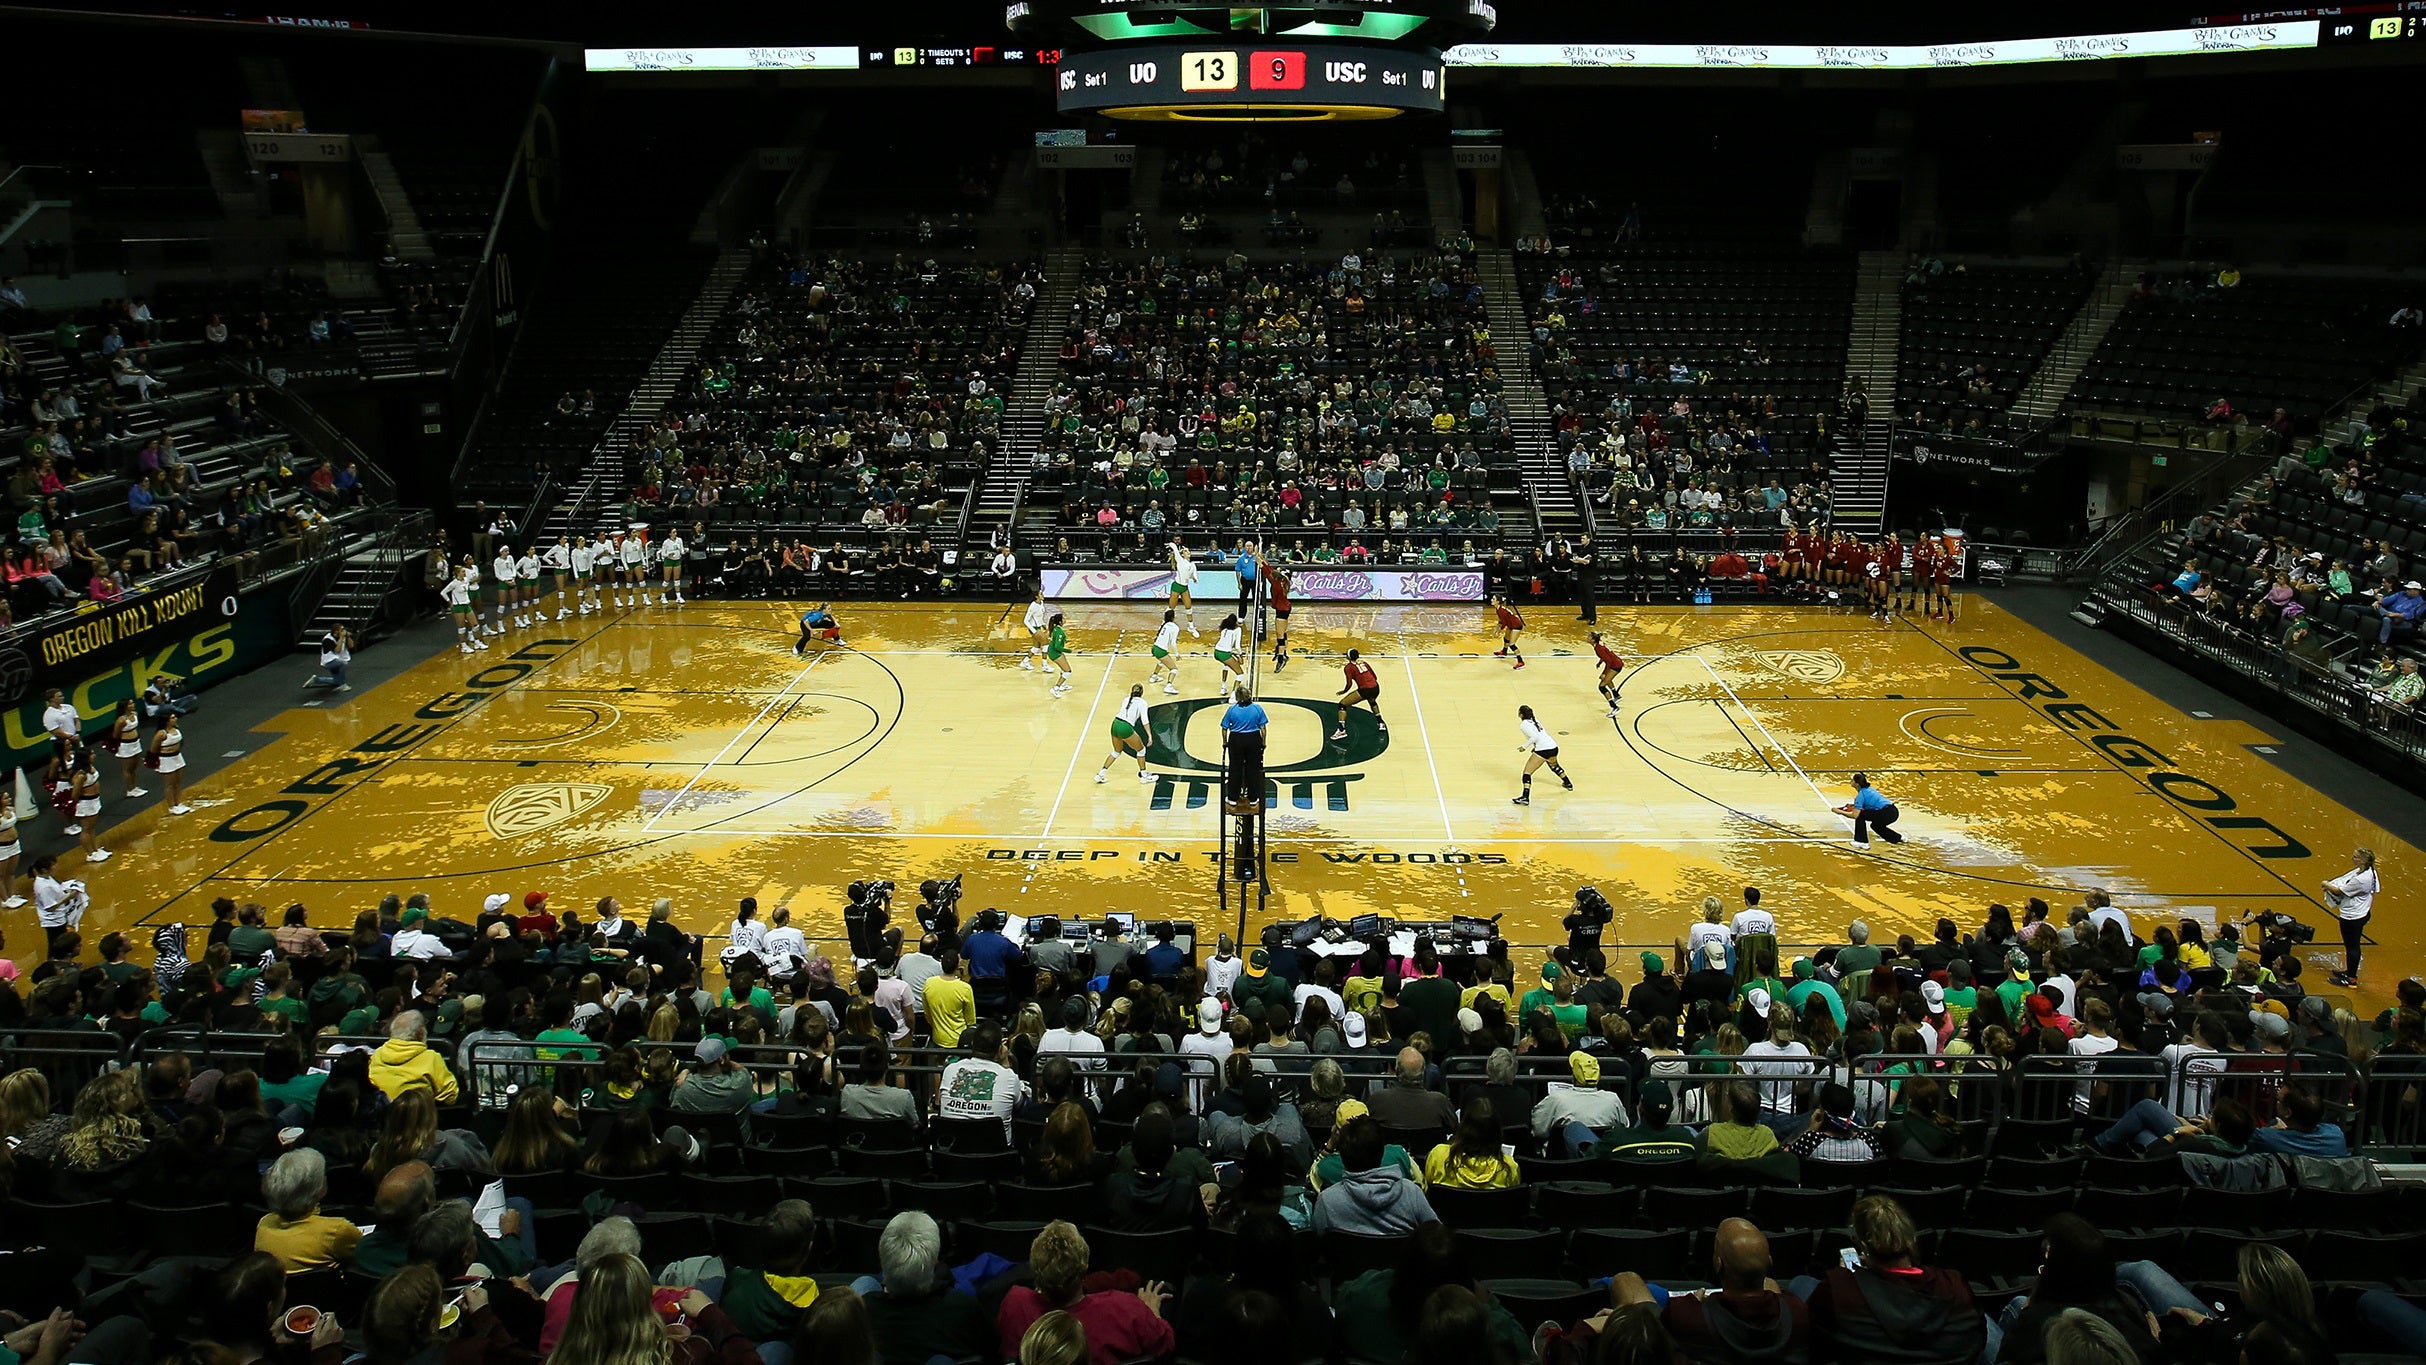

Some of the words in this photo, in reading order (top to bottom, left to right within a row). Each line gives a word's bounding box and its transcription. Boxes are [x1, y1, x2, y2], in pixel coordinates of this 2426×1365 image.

[2377, 22, 2396, 35] 13
[2409, 18, 2416, 26] 2
[899, 52, 913, 62] 13
[1004, 51, 1023, 60] USC
[1130, 62, 1157, 84] UO
[1195, 58, 1224, 81] 13
[1271, 58, 1286, 81] 9
[1326, 62, 1367, 82] USC
[1060, 70, 1076, 91] USC
[1085, 73, 1100, 87] Set
[1101, 71, 1106, 86] 1
[1382, 71, 1401, 86] Set
[1402, 72, 1407, 86] 1
[1422, 70, 1435, 89] UO
[252, 143, 279, 154] 120
[320, 144, 343, 155] 121
[1040, 154, 1058, 163] 102
[1114, 153, 1131, 163] 103
[1456, 153, 1474, 162] 103
[1478, 153, 1496, 162] 104
[2121, 154, 2141, 164] 105
[287, 367, 359, 379] NETWORKS
[1929, 453, 1991, 466] NETWORKS
[1303, 574, 1344, 591] Carl's
[1346, 574, 1372, 593] Jr.
[1417, 575, 1459, 593] Carl's
[42, 627, 113, 666] OREGON
[116, 604, 153, 640] KILL
[208, 638, 579, 842] OREGON
[1958, 646, 2312, 859] OREGON
[986, 849, 1120, 861] DEEP
[1138, 851, 1181, 862] IN
[1202, 851, 1299, 863] TE
[1320, 852, 1508, 864] WOODS
[948, 1100, 988, 1111] OREGON
